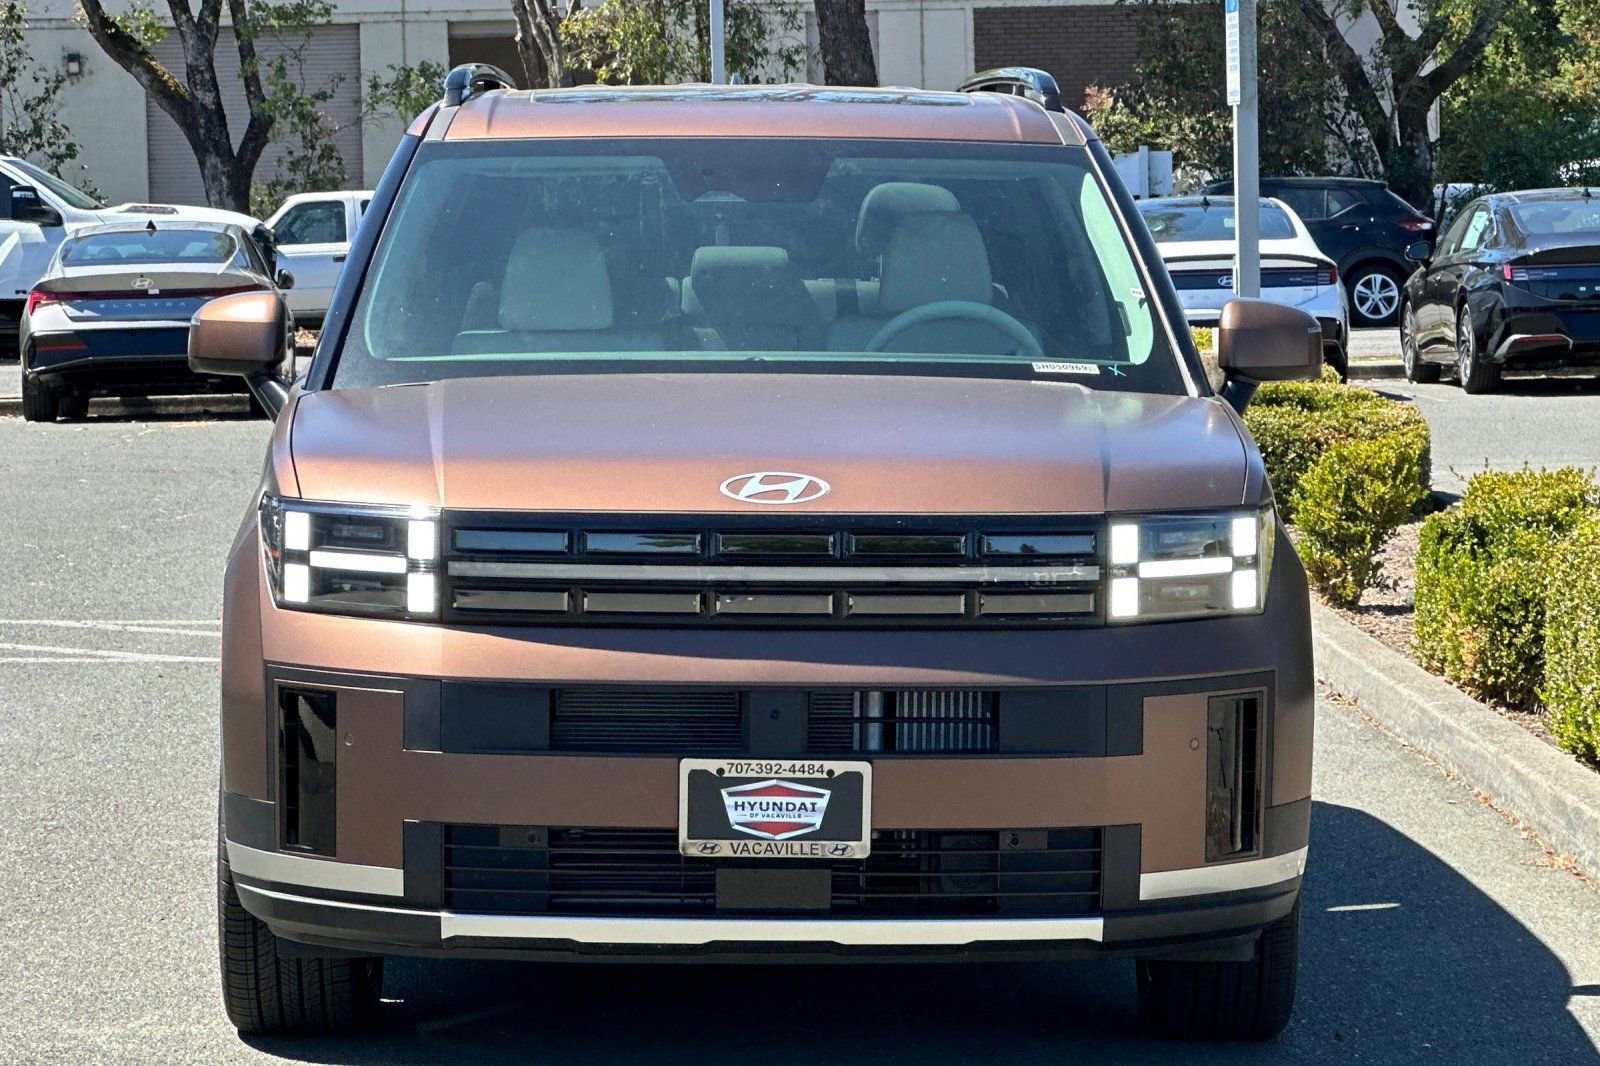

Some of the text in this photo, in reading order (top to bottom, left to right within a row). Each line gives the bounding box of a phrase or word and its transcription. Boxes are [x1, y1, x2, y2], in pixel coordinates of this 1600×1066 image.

[726, 762, 825, 775] 707-392-4484
[734, 801, 818, 812] HYUNDAI
[730, 842, 820, 856] VACAVILLE
